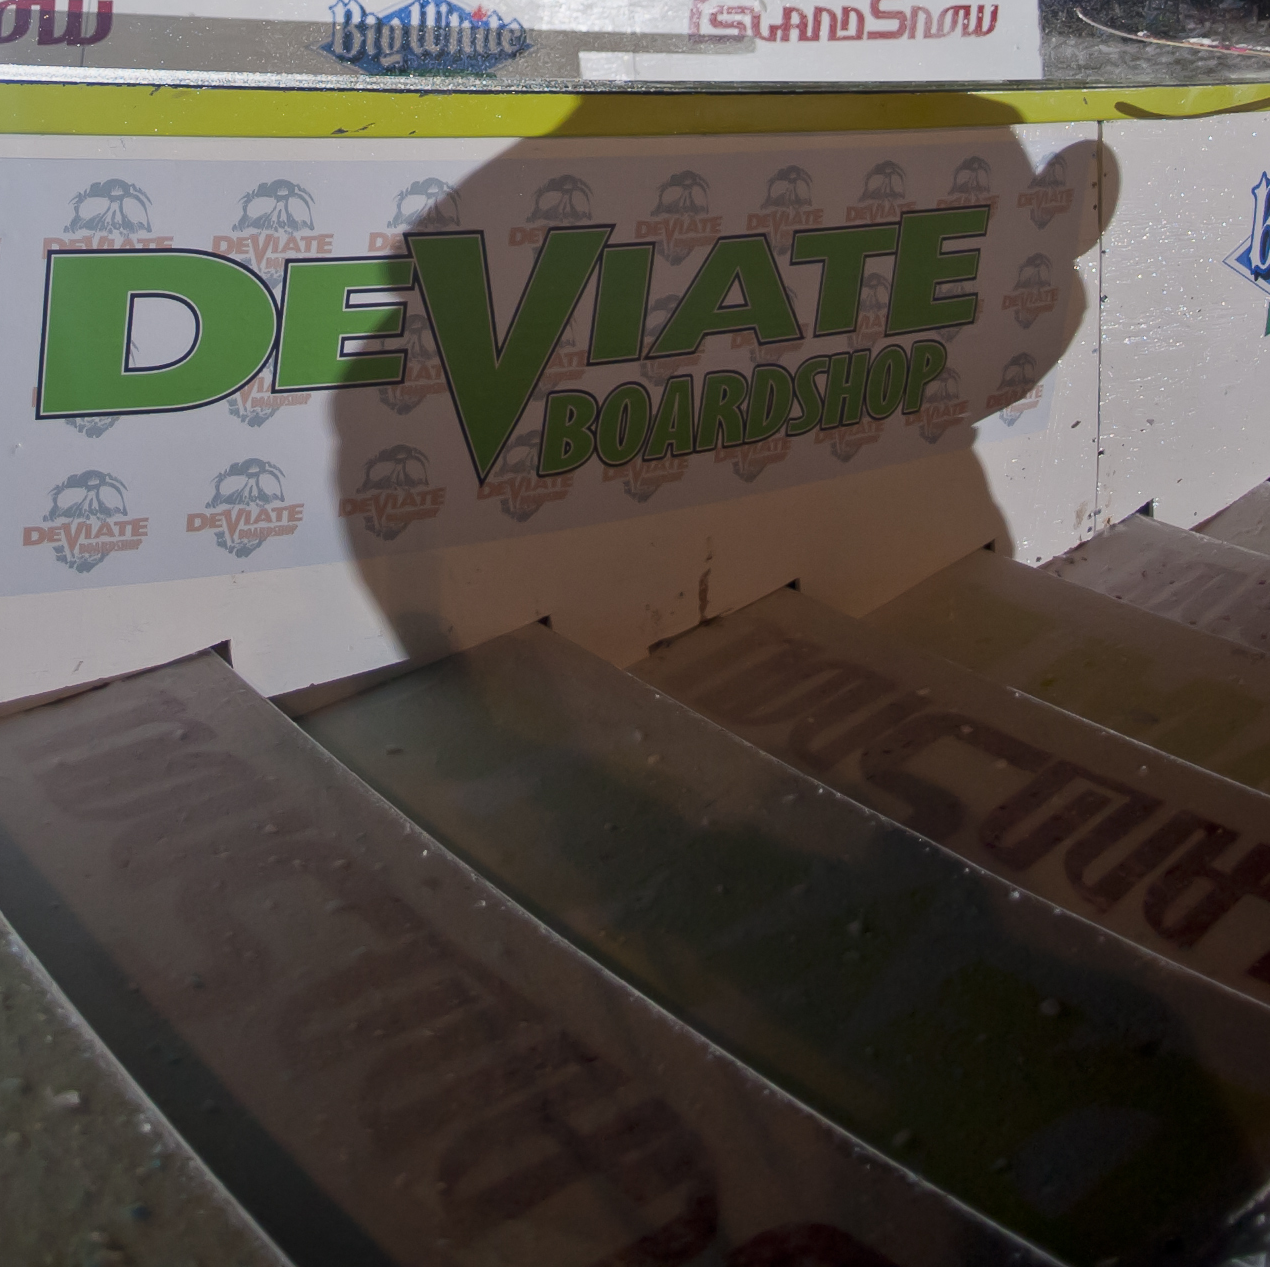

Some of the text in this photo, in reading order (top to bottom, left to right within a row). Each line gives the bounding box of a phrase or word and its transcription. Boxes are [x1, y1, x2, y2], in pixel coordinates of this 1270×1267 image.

[211, 233, 334, 273] DEVIATE
[35, 204, 991, 487] DEVIATE
[536, 339, 948, 478] BOARDSHOP
[22, 517, 150, 555] DEVIATE
[186, 503, 305, 539] DEVIATE
